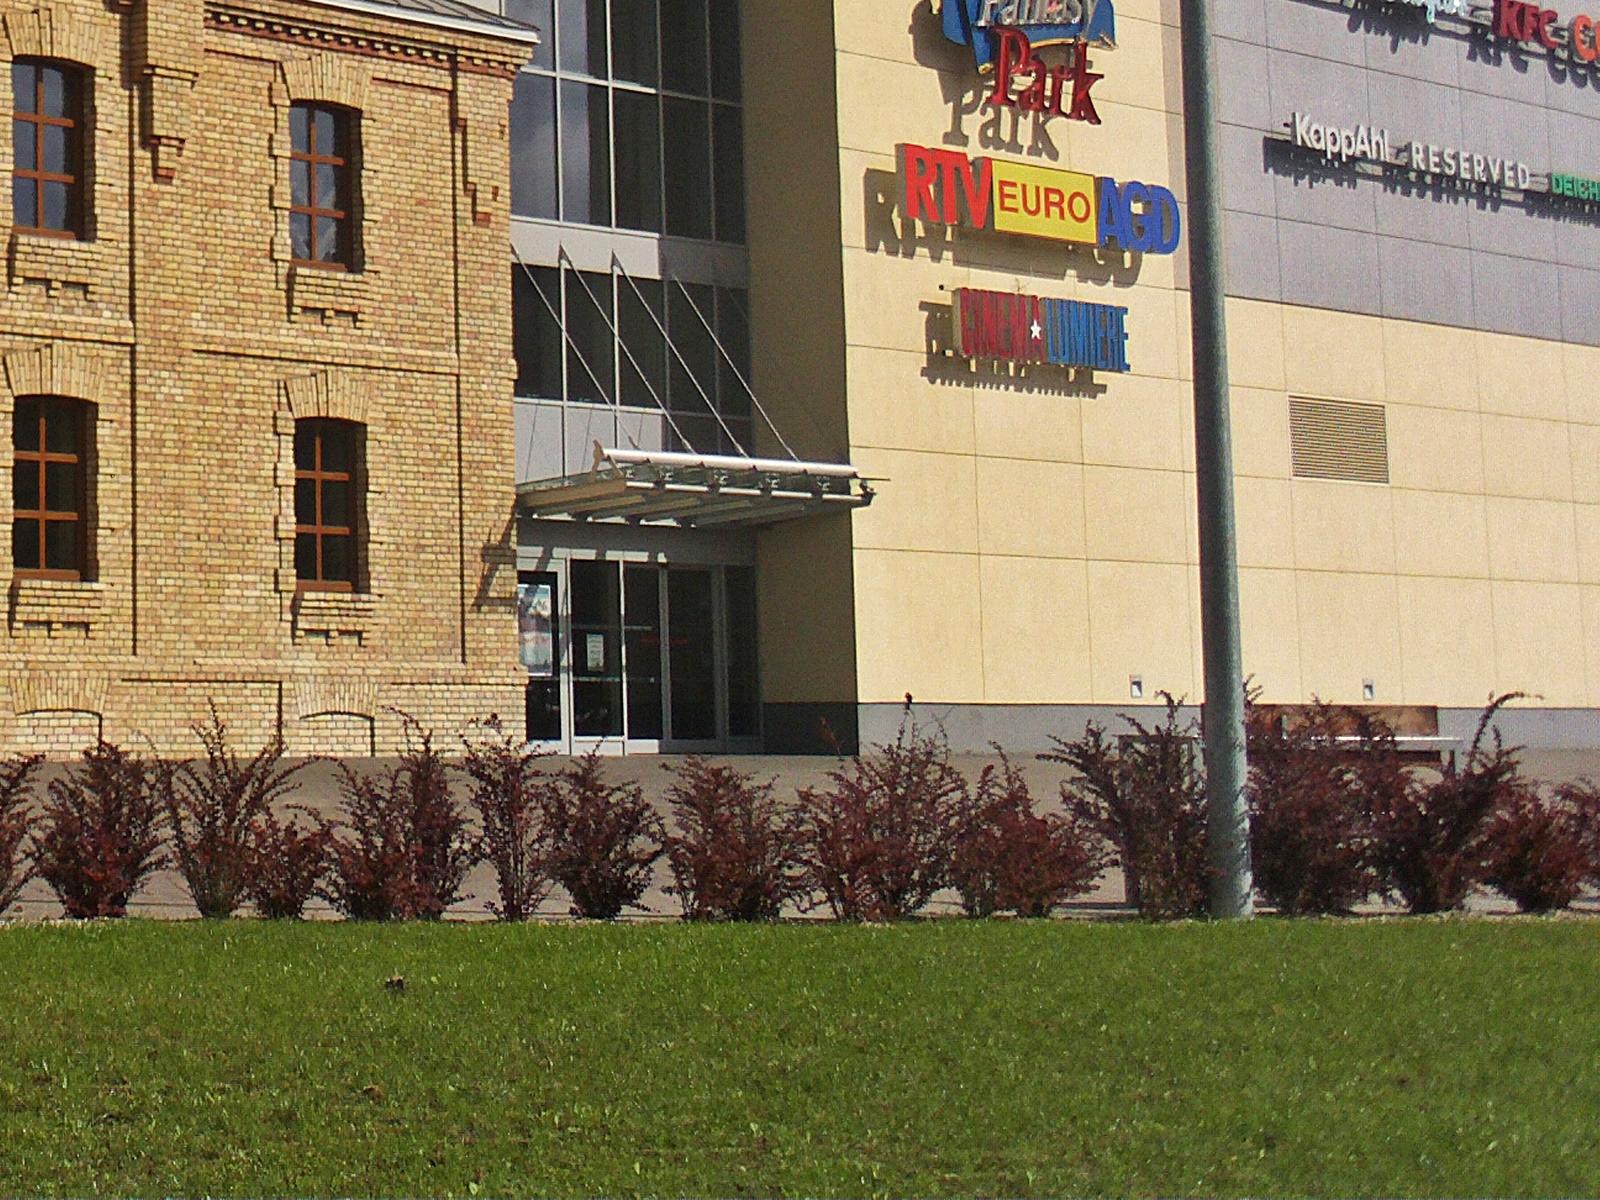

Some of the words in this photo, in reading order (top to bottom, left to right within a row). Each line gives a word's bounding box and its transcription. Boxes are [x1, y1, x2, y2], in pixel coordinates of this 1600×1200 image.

[985, 26, 1104, 125] Park
[1294, 111, 1389, 162] KappAhl
[1410, 142, 1529, 189] RESERVED
[898, 143, 992, 229] RTV
[998, 180, 1091, 224] EURO
[1098, 176, 1180, 255] AGD
